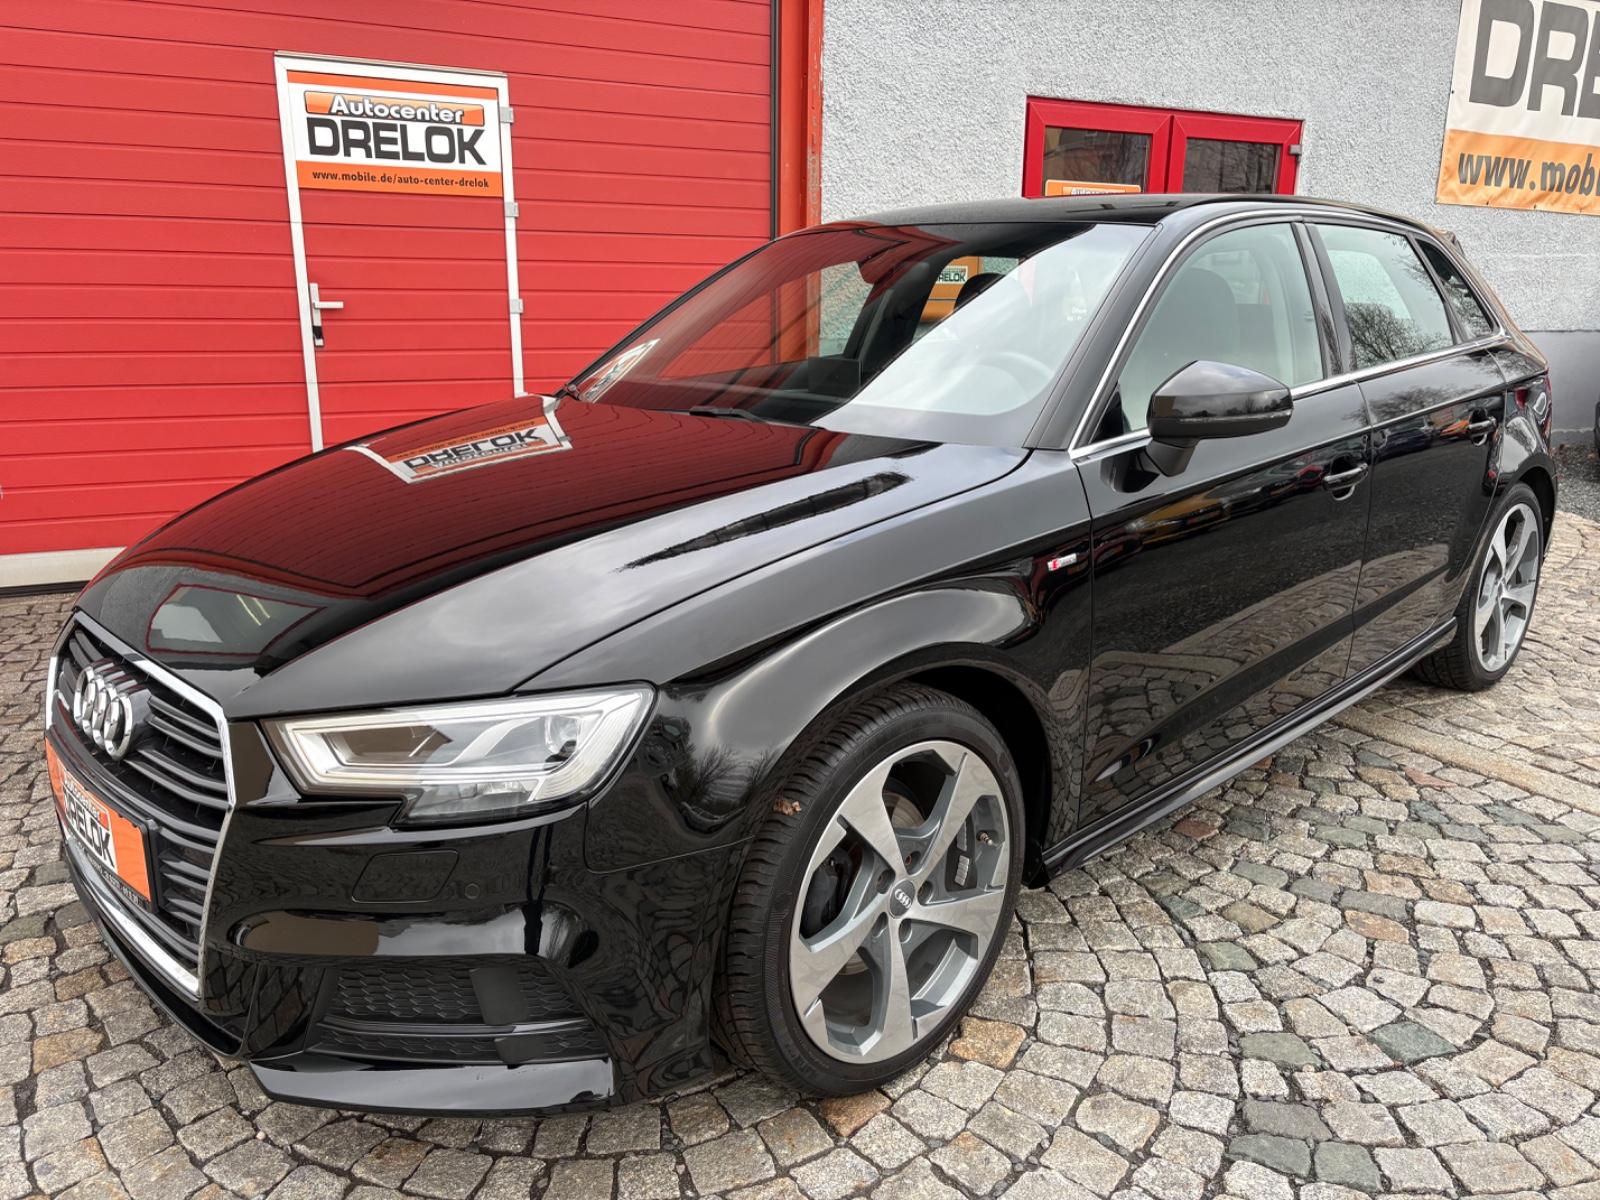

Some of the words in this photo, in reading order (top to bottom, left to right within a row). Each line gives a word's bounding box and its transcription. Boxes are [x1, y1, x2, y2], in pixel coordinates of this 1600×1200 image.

[331, 94, 464, 124] Autocenter
[306, 117, 487, 166] DRELOK
[312, 169, 489, 188] www.mobile.de/auto-center-drelok
[938, 272, 966, 282] RELOK
